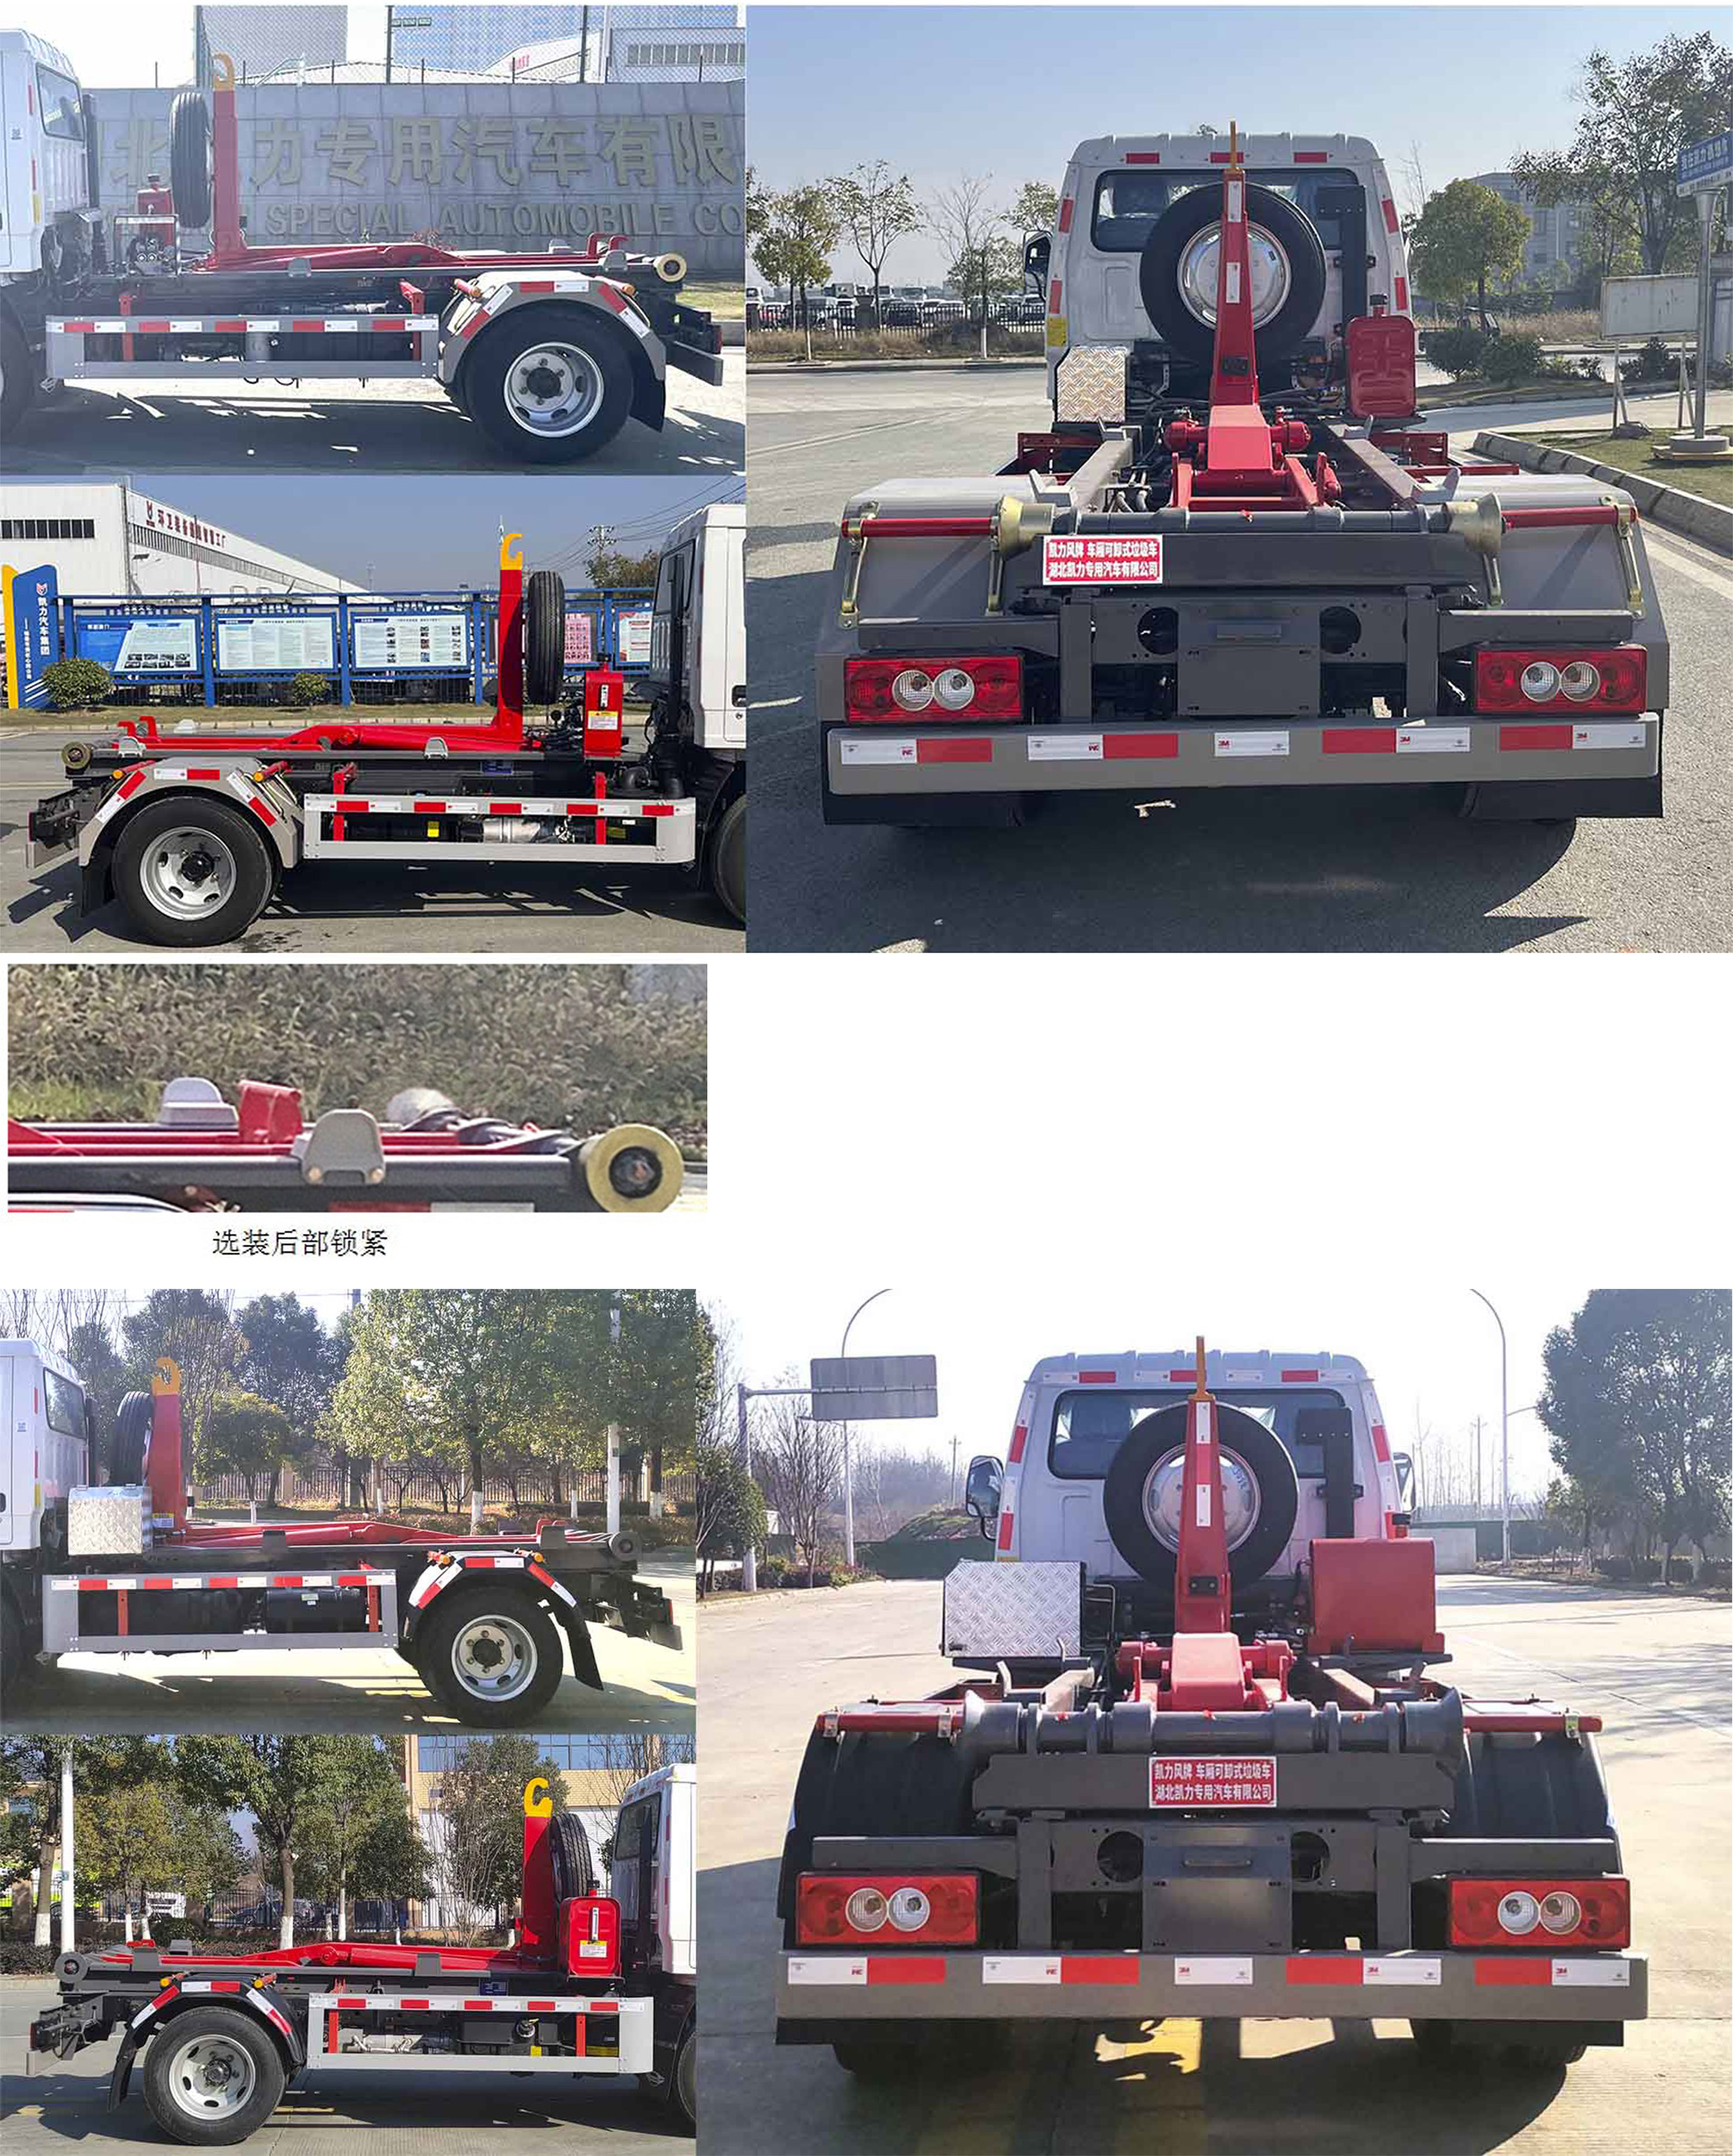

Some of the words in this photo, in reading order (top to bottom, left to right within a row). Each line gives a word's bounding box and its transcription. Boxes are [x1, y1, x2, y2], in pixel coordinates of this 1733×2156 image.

[96, 114, 737, 187] 北力专用汽车有限
[266, 203, 412, 236] SPECIAL
[438, 203, 674, 236] AUTOMOBILE
[1048, 561, 1158, 577] 湖北凯力专用汽车有限公司
[1154, 1763, 1193, 1780] 凯力风牌
[1196, 1763, 1272, 1780] 车厢可卸式垃圾车
[1155, 1784, 1272, 1800] 湖北凯力专用汽车有限公司
